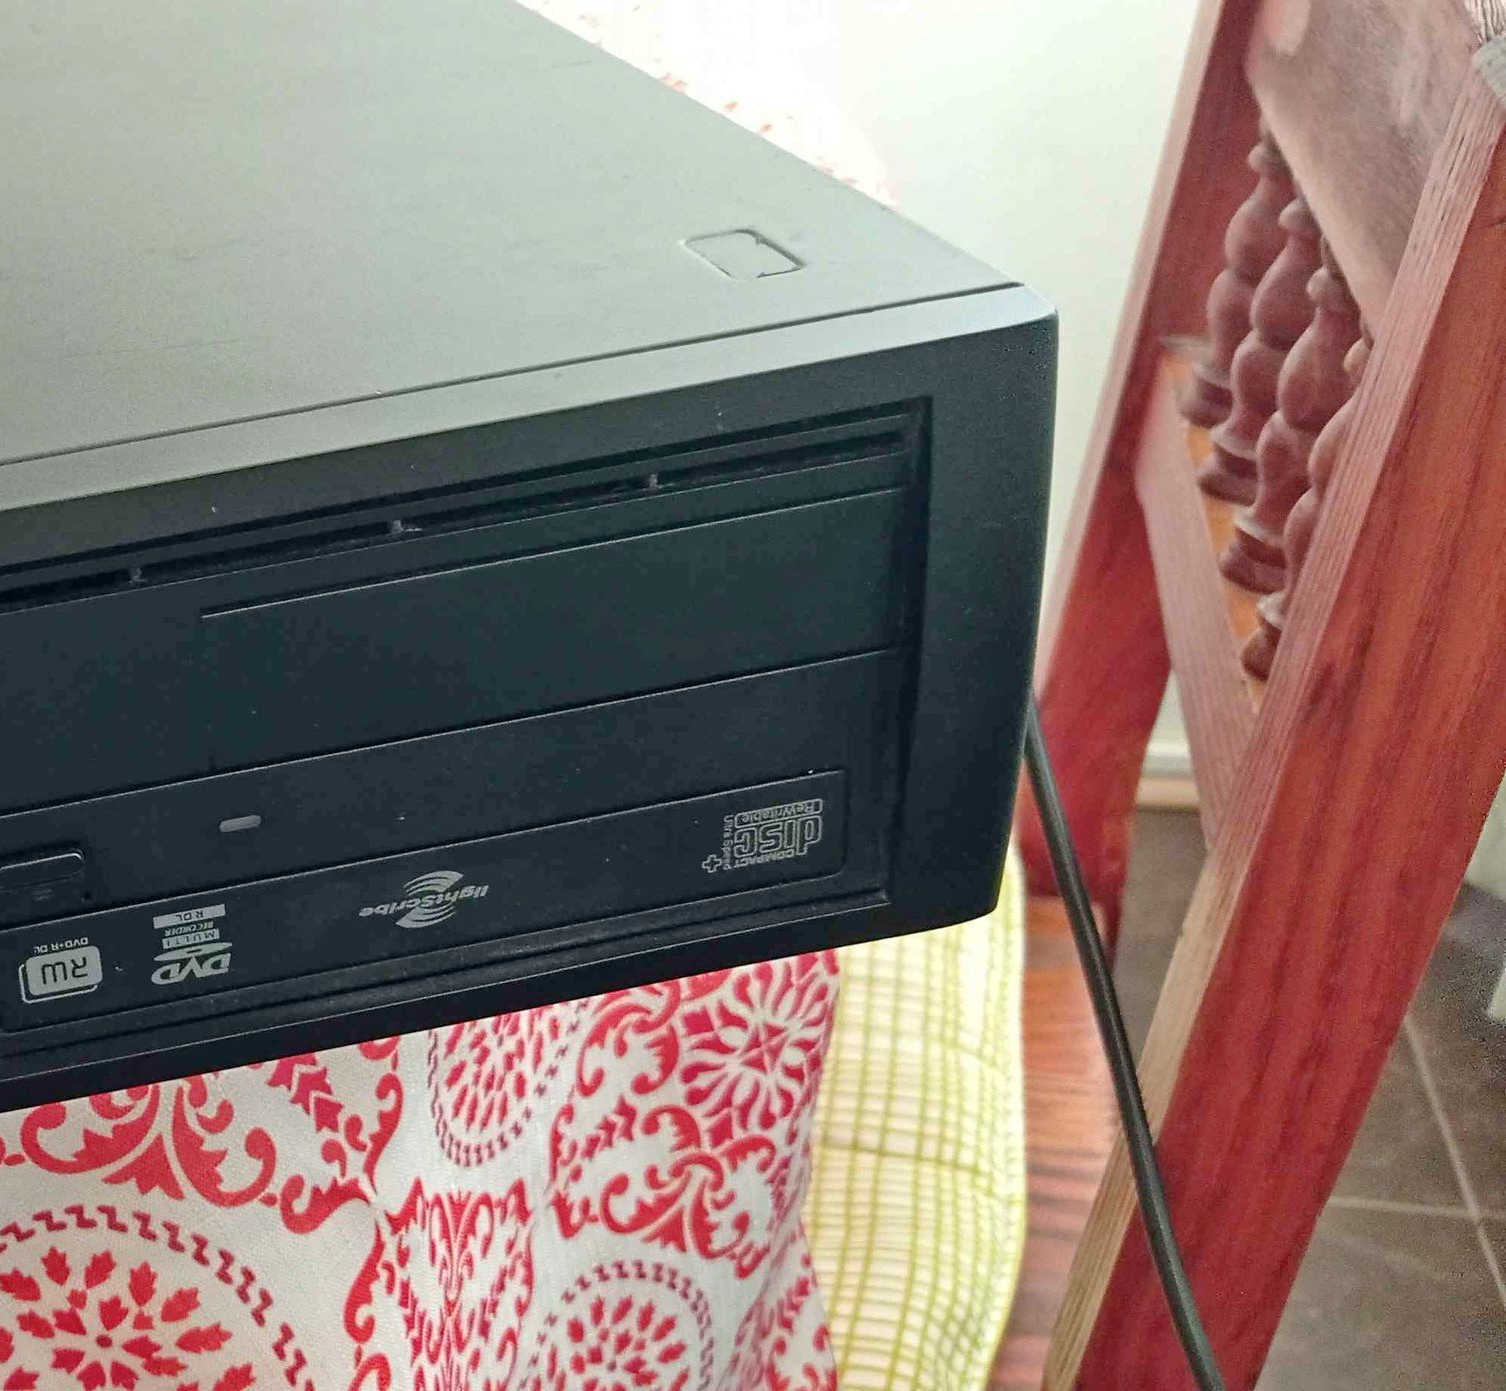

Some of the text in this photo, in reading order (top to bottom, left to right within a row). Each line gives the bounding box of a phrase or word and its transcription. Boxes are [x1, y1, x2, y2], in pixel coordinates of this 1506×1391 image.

[741, 800, 815, 825] ReWritable
[733, 814, 822, 858] disc
[733, 848, 795, 870] COMPACT
[164, 919, 214, 937] RECORDER
[165, 930, 216, 948] MULTI
[40, 956, 89, 985] RW
[150, 952, 232, 986] DVD
